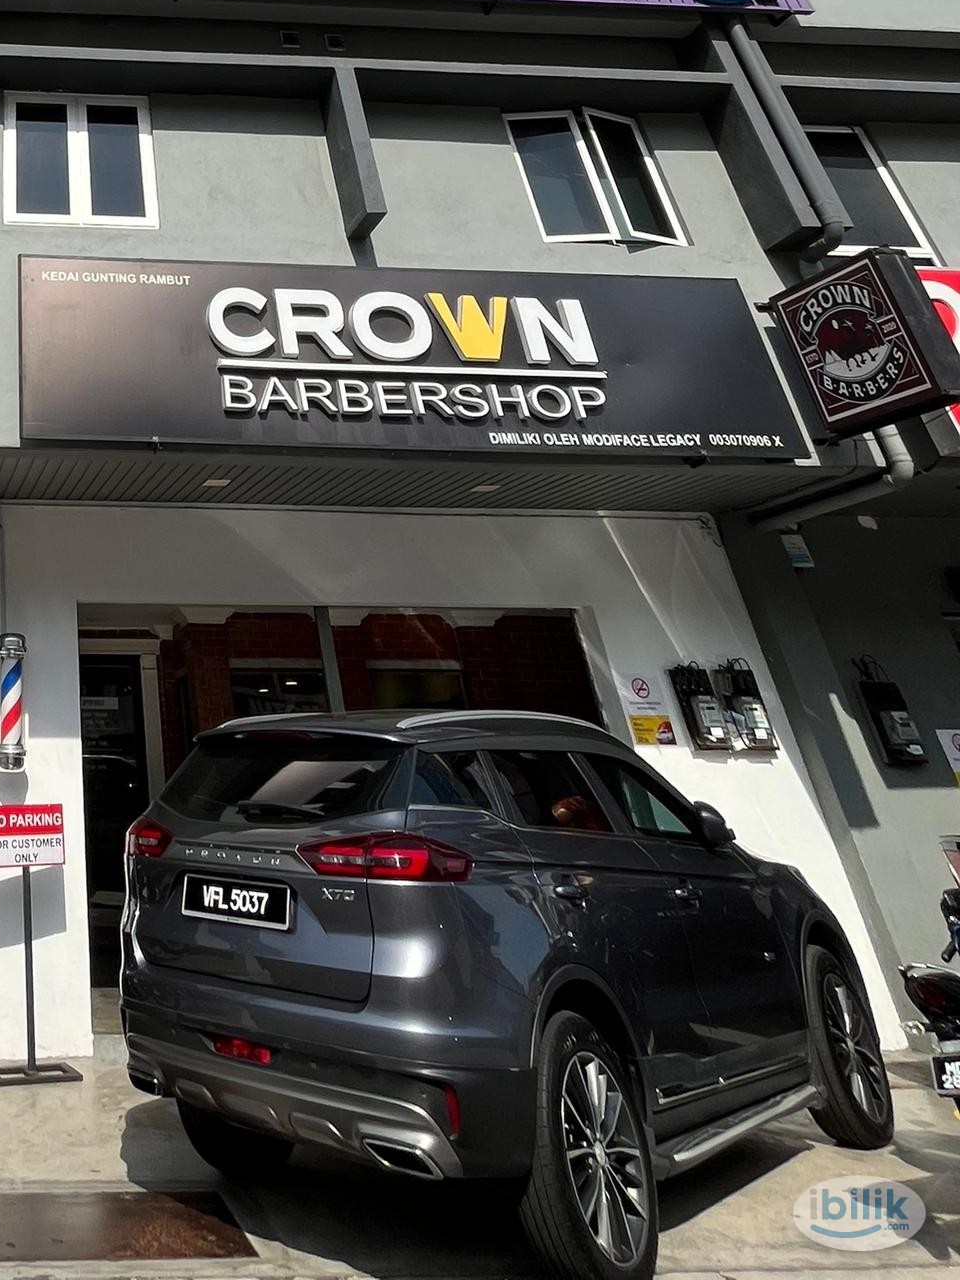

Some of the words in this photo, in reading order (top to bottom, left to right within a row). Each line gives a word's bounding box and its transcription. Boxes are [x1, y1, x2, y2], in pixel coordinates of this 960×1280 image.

[41, 271, 79, 282] KEDAI
[81, 272, 137, 284] GUNTING
[139, 274, 191, 286] RAMBUT
[800, 284, 873, 332] CROWN
[206, 286, 601, 367] CROWN
[221, 373, 607, 420] BARBERSHOP
[488, 431, 541, 446] DIMILIKI
[543, 432, 579, 446] OLEH
[581, 433, 649, 447] MODIFACE
[650, 434, 702, 447] LEGACY
[708, 434, 772, 448] 003070906
[772, 435, 784, 448] X
[9, 813, 62, 827] PARKING
[11, 837, 62, 849] CUSTOMER
[14, 852, 39, 863] ONLY
[202, 884, 229, 910] VFL
[230, 889, 270, 915] 5037
